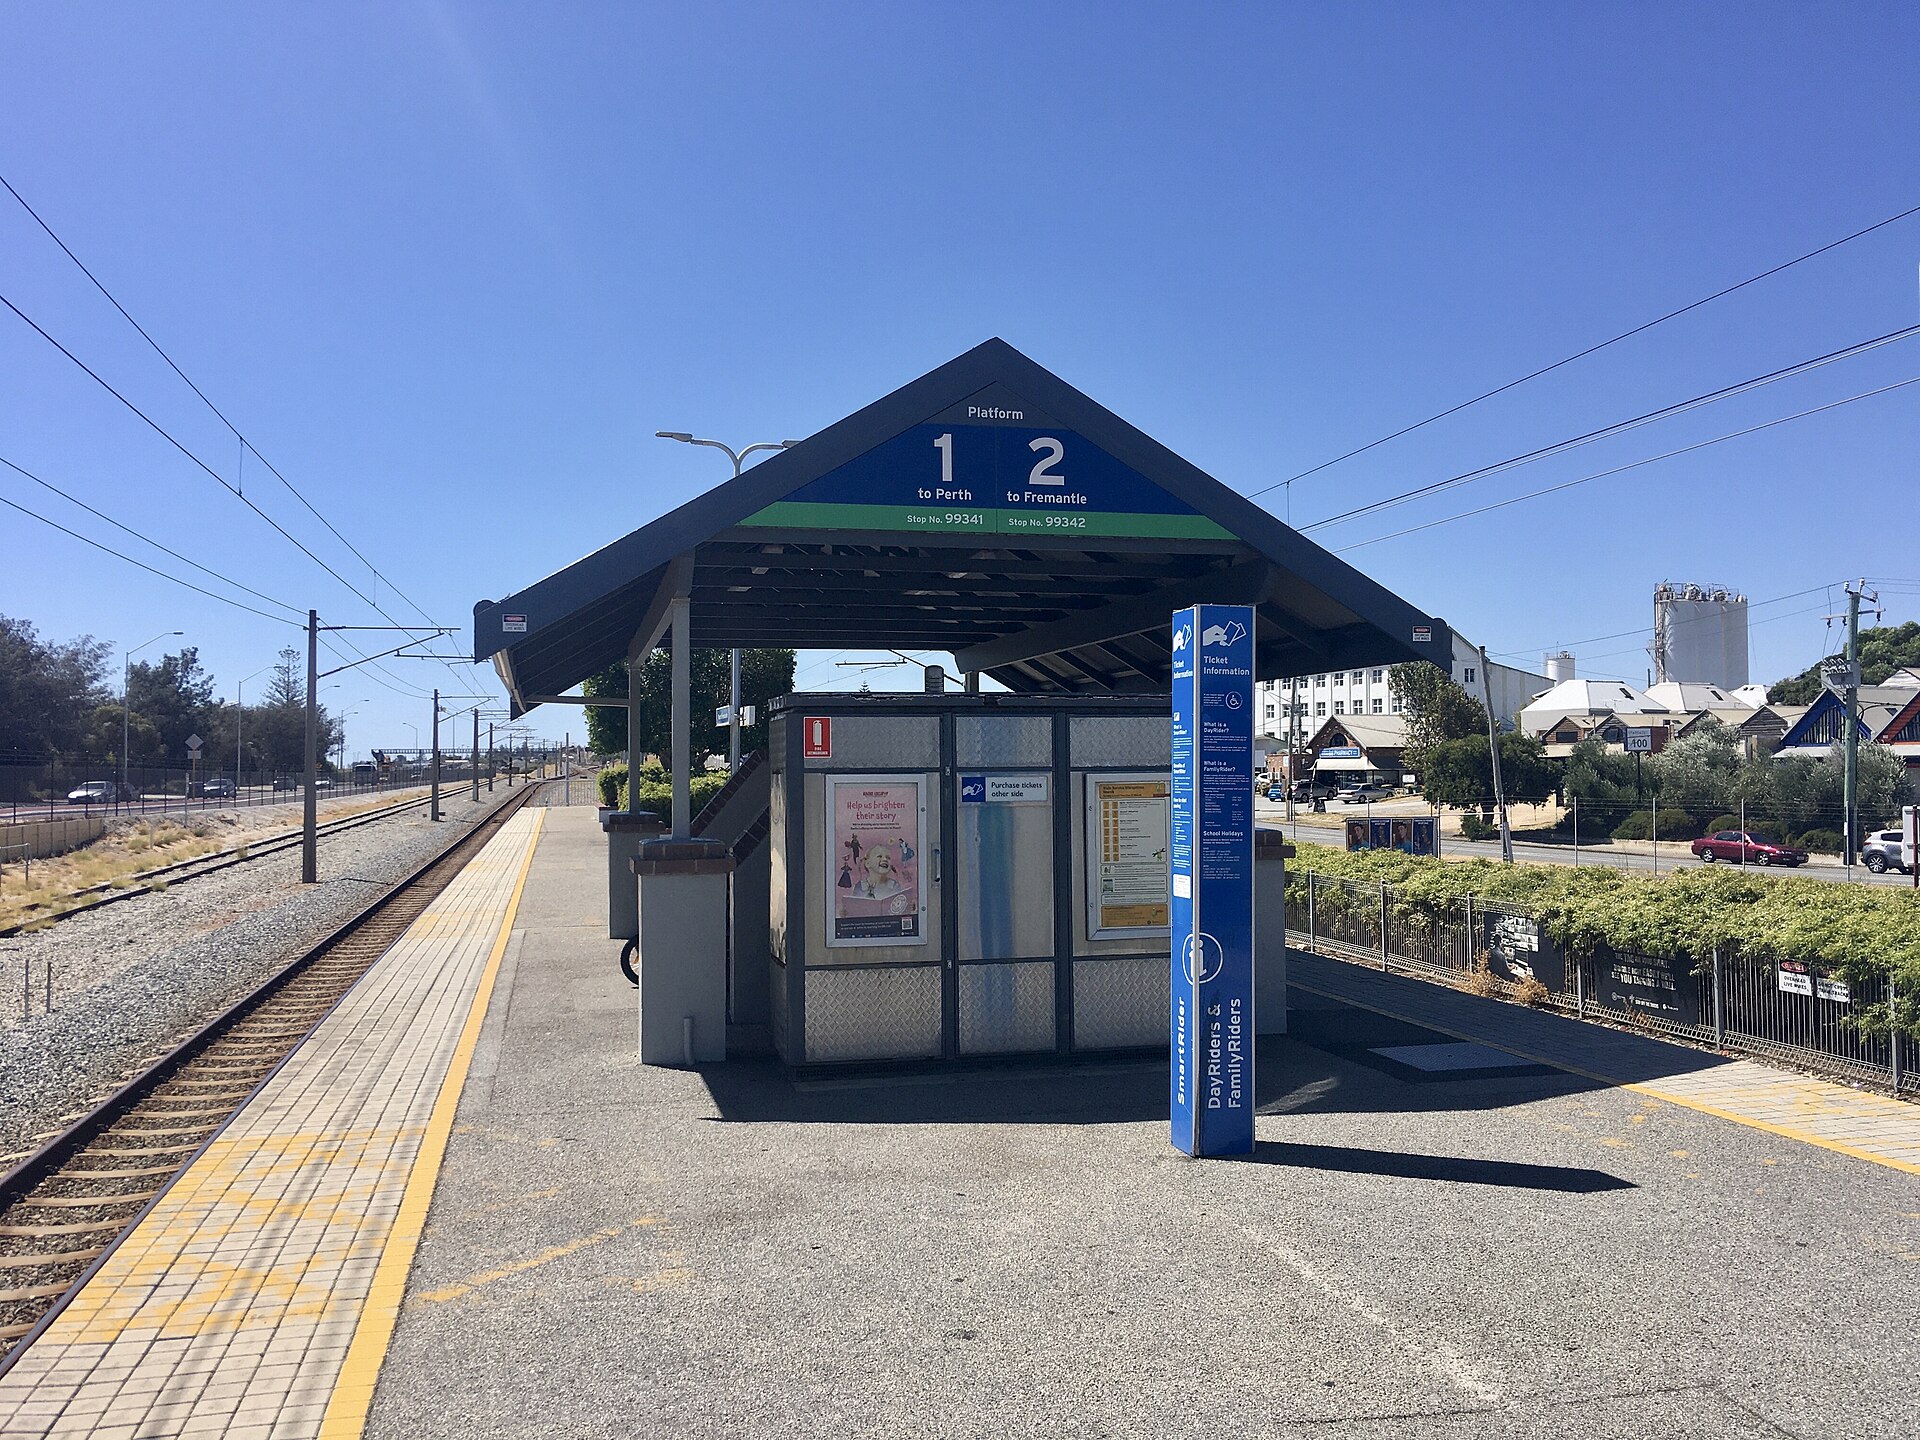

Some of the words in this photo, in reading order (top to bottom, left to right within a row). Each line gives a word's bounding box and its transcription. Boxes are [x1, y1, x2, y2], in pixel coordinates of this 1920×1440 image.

[967, 406, 1023, 421] Platform
[933, 433, 953, 482] 1
[1028, 437, 1065, 486] 2
[918, 488, 932, 500] to
[936, 488, 972, 501] Perth
[1007, 491, 1020, 503] to
[1024, 491, 1087, 505] Fremantle
[907, 514, 926, 526] Stop
[929, 515, 943, 524] No.
[945, 513, 984, 525] 99341
[1008, 518, 1028, 529] Stop
[1030, 518, 1043, 527] No.
[1045, 516, 1086, 528] 99342
[1204, 656, 1228, 664] Ticket
[1204, 667, 1250, 676] Information
[847, 801, 862, 811] Help
[874, 801, 905, 811] brighten
[856, 811, 874, 820] their
[876, 812, 896, 822] story
[1208, 1003, 1221, 1016] &
[1177, 997, 1185, 1105] SmartRider
[1228, 998, 1243, 1108] FamilyRiders
[1208, 1022, 1223, 1109] DayRiders
